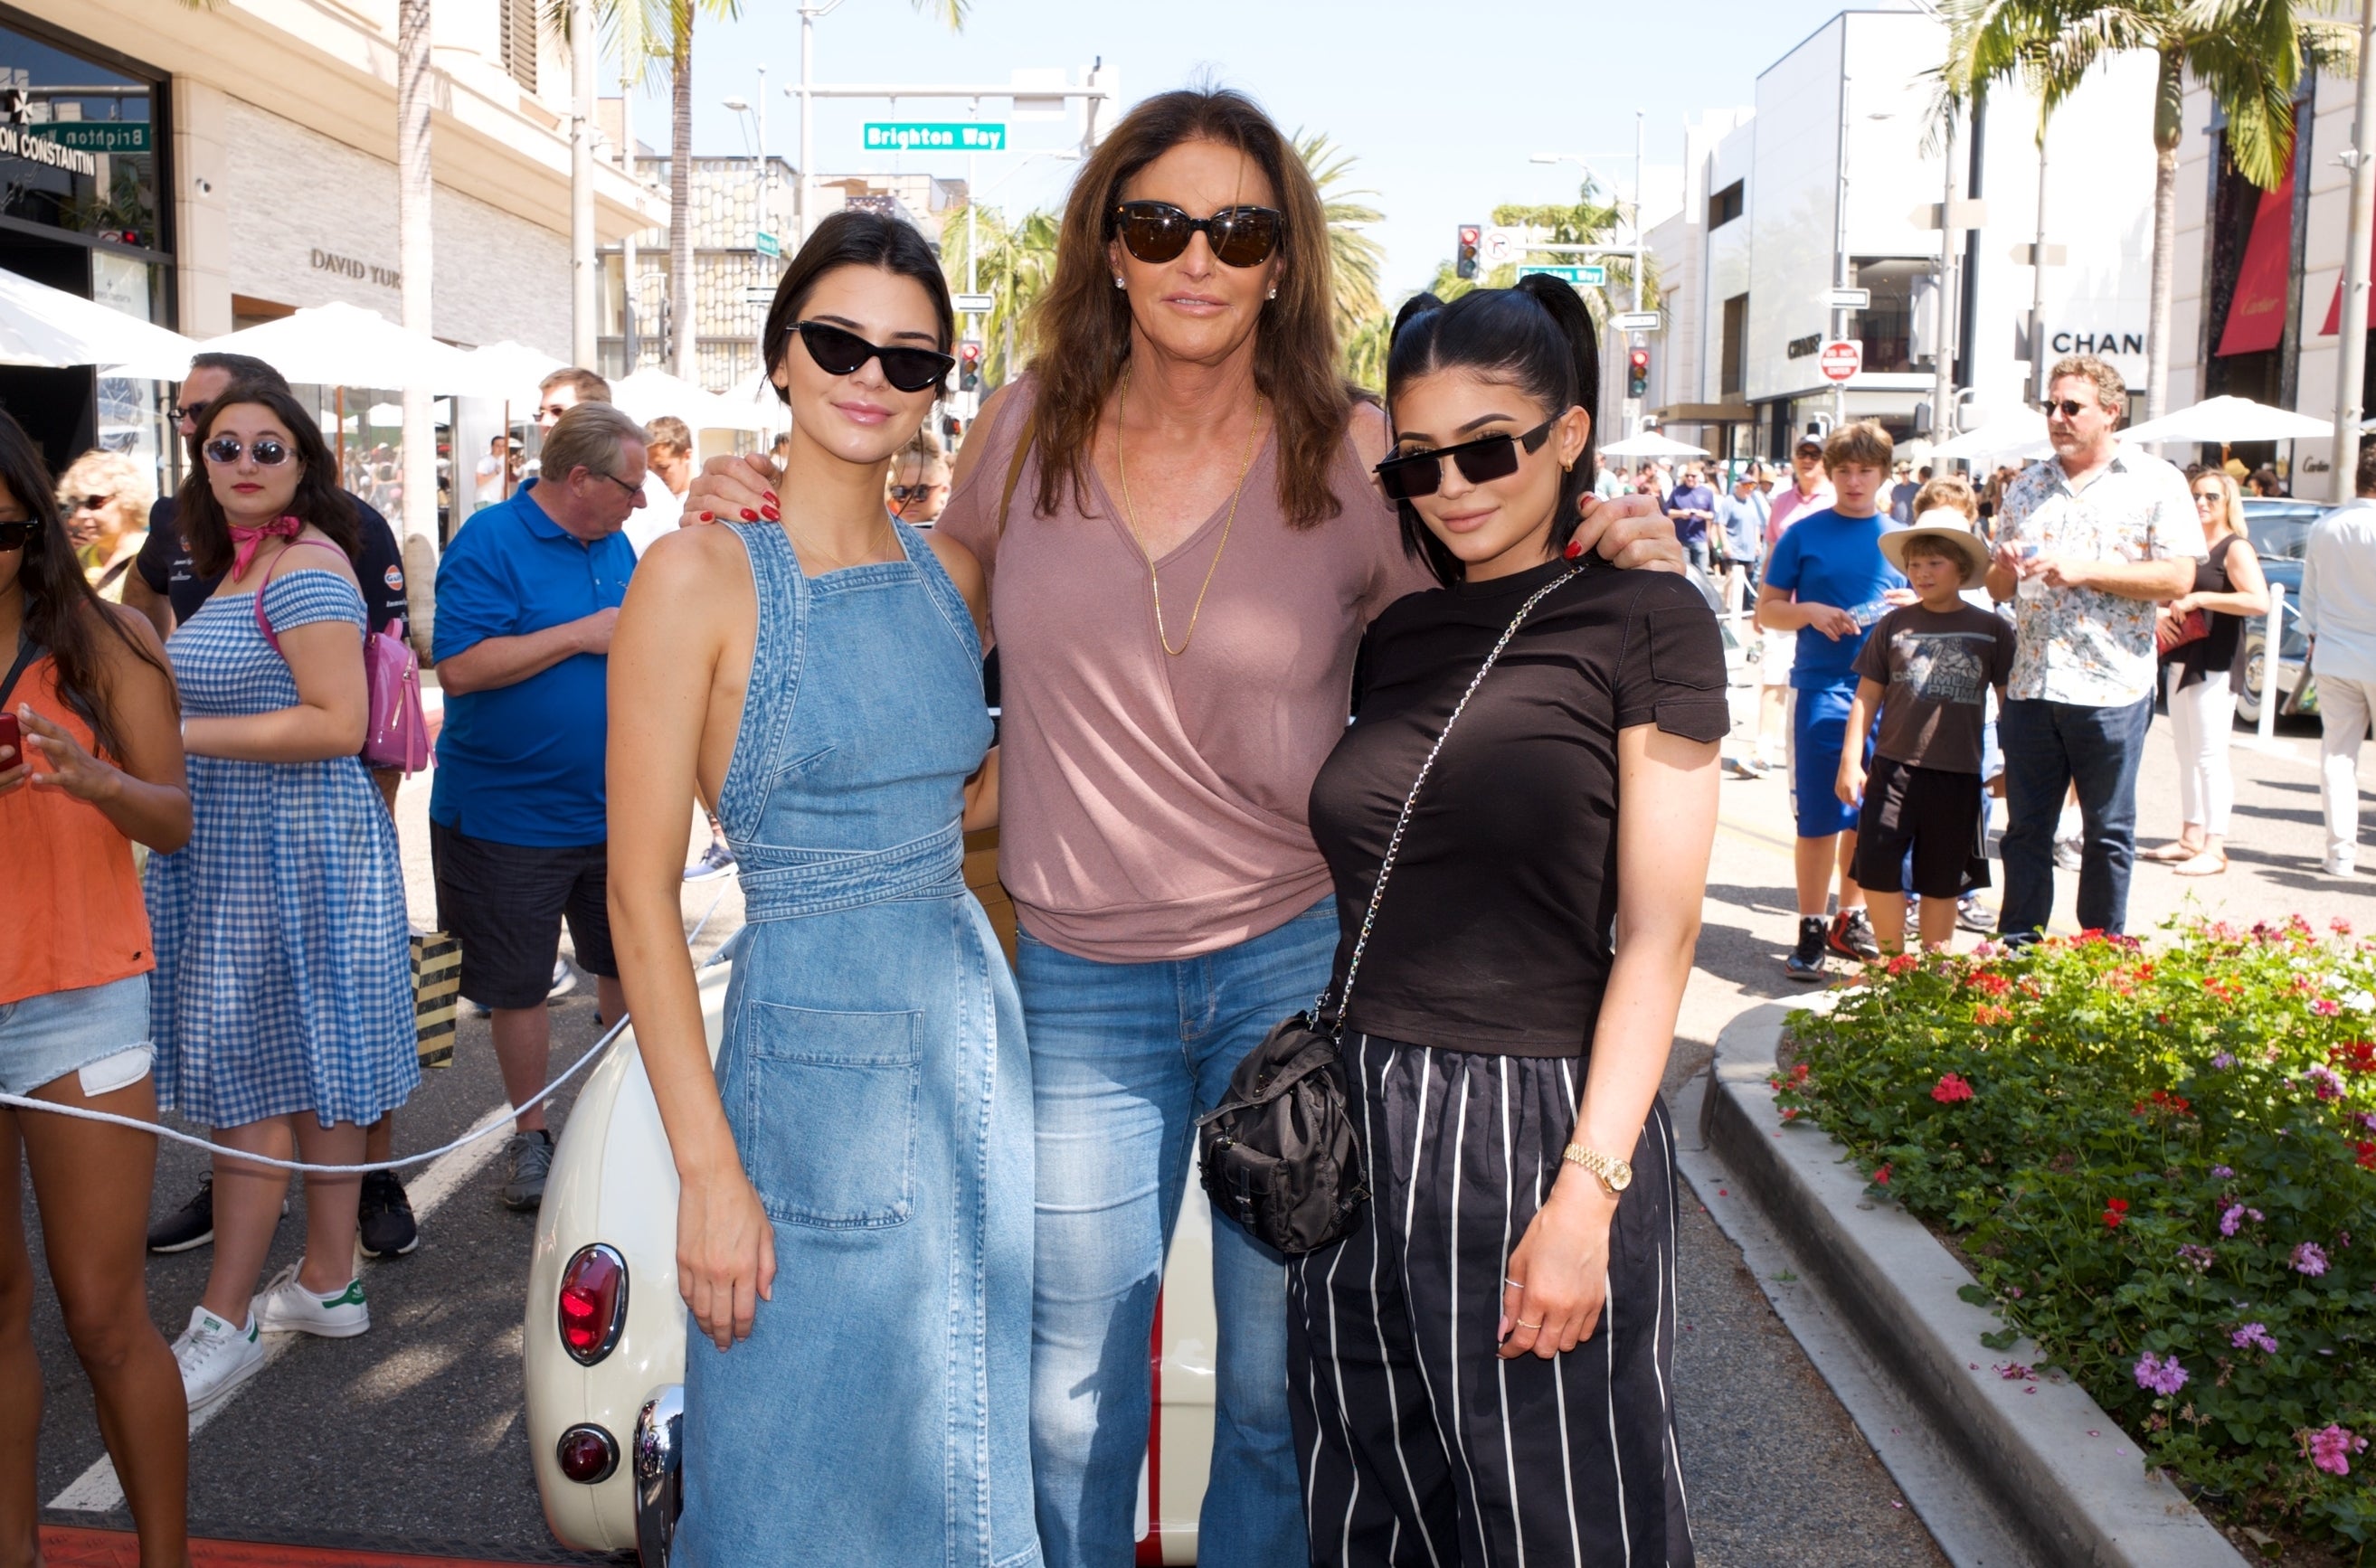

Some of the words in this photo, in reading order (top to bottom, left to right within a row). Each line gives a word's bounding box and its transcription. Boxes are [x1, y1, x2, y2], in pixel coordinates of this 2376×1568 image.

[867, 127, 953, 150] Brighton
[962, 128, 1001, 150] Way
[21, 134, 95, 176] CONSTANTIN
[311, 248, 365, 279] DAVID
[1576, 269, 1600, 282] Way
[2052, 333, 2143, 354] CHAN
